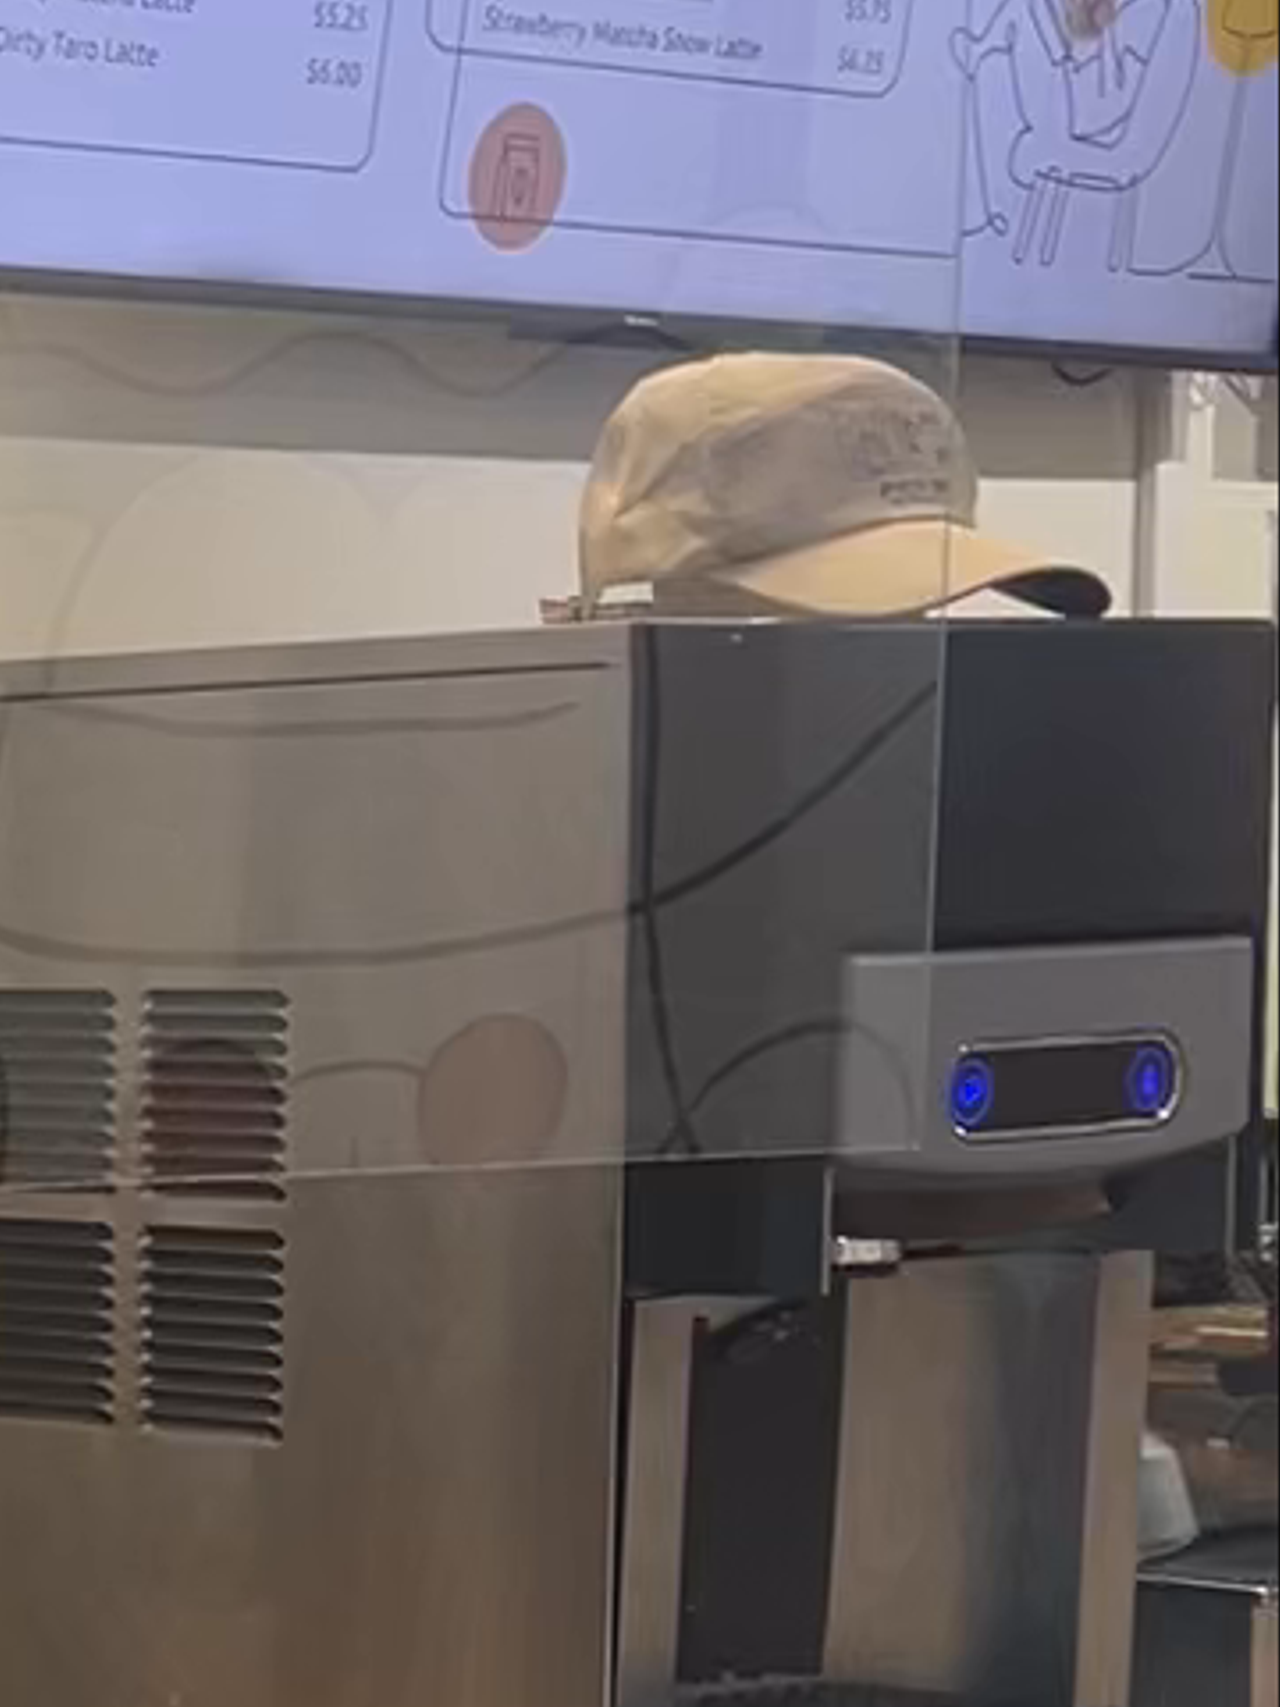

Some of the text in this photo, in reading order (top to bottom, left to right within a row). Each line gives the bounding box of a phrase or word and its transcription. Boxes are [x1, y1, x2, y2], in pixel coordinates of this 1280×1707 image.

[313, 0, 369, 33] $5.25
[483, 3, 764, 62] Strawberry Matcha Snow Latte
[52, 31, 99, 63] Taro
[104, 39, 160, 69] Latte
